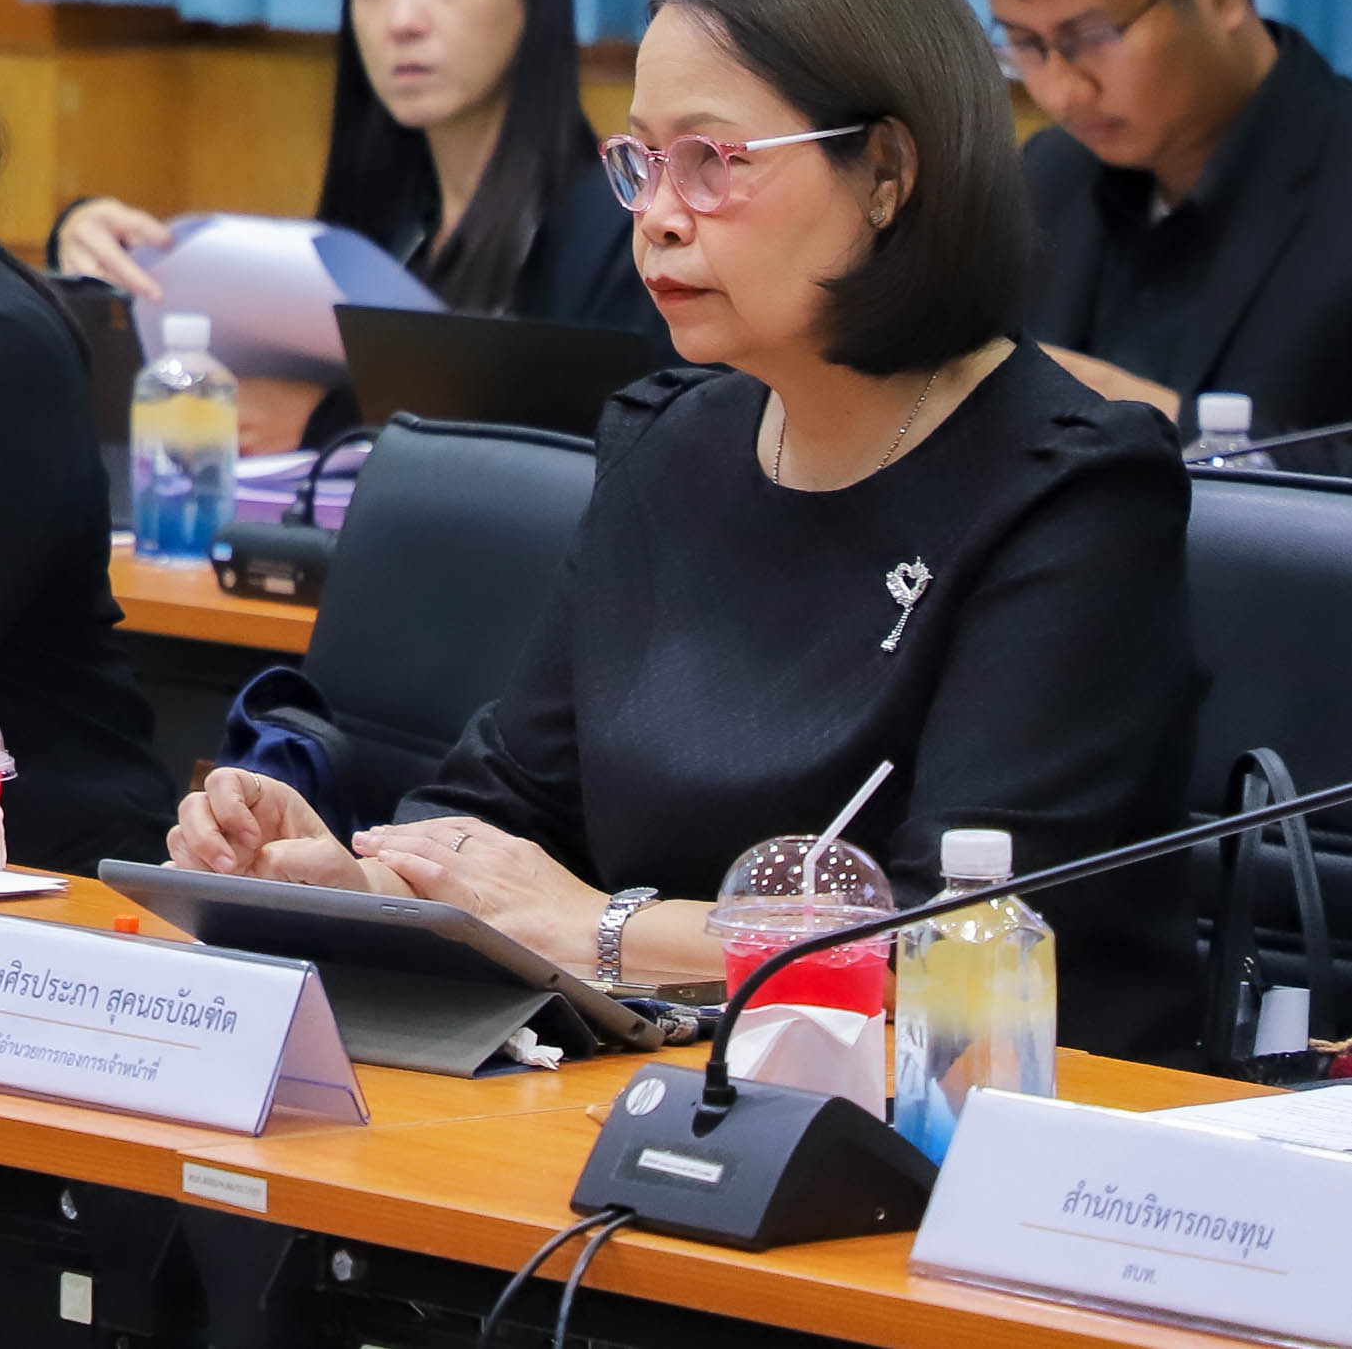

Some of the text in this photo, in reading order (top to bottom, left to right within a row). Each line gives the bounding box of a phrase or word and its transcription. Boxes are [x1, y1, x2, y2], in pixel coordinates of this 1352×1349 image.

[106, 987, 238, 1034] สุคนธบัณฑิต
[1063, 1180, 1274, 1257] สำนักบริหารกองทุน
